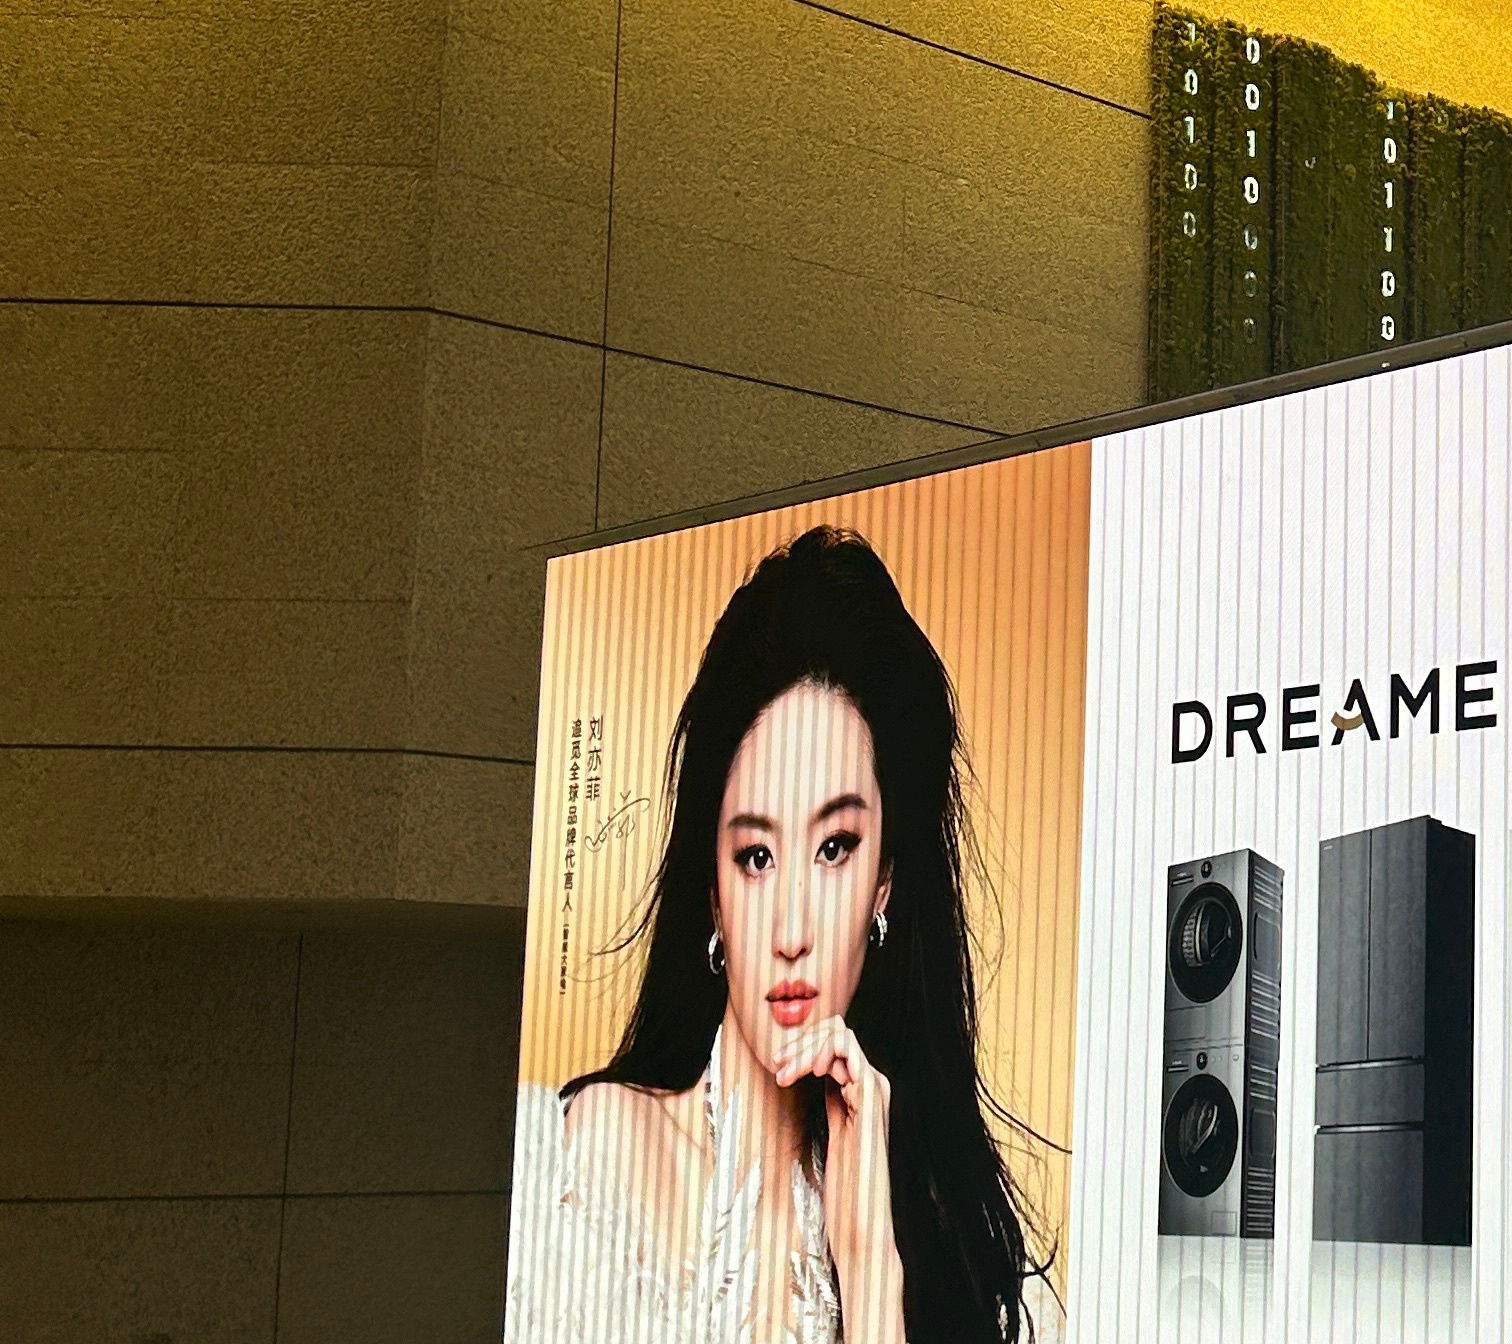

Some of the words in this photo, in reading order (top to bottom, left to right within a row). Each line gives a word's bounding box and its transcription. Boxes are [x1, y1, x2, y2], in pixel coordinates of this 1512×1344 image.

[586, 714, 603, 802] 刘亦菲
[1171, 659, 1498, 765] DREAME
